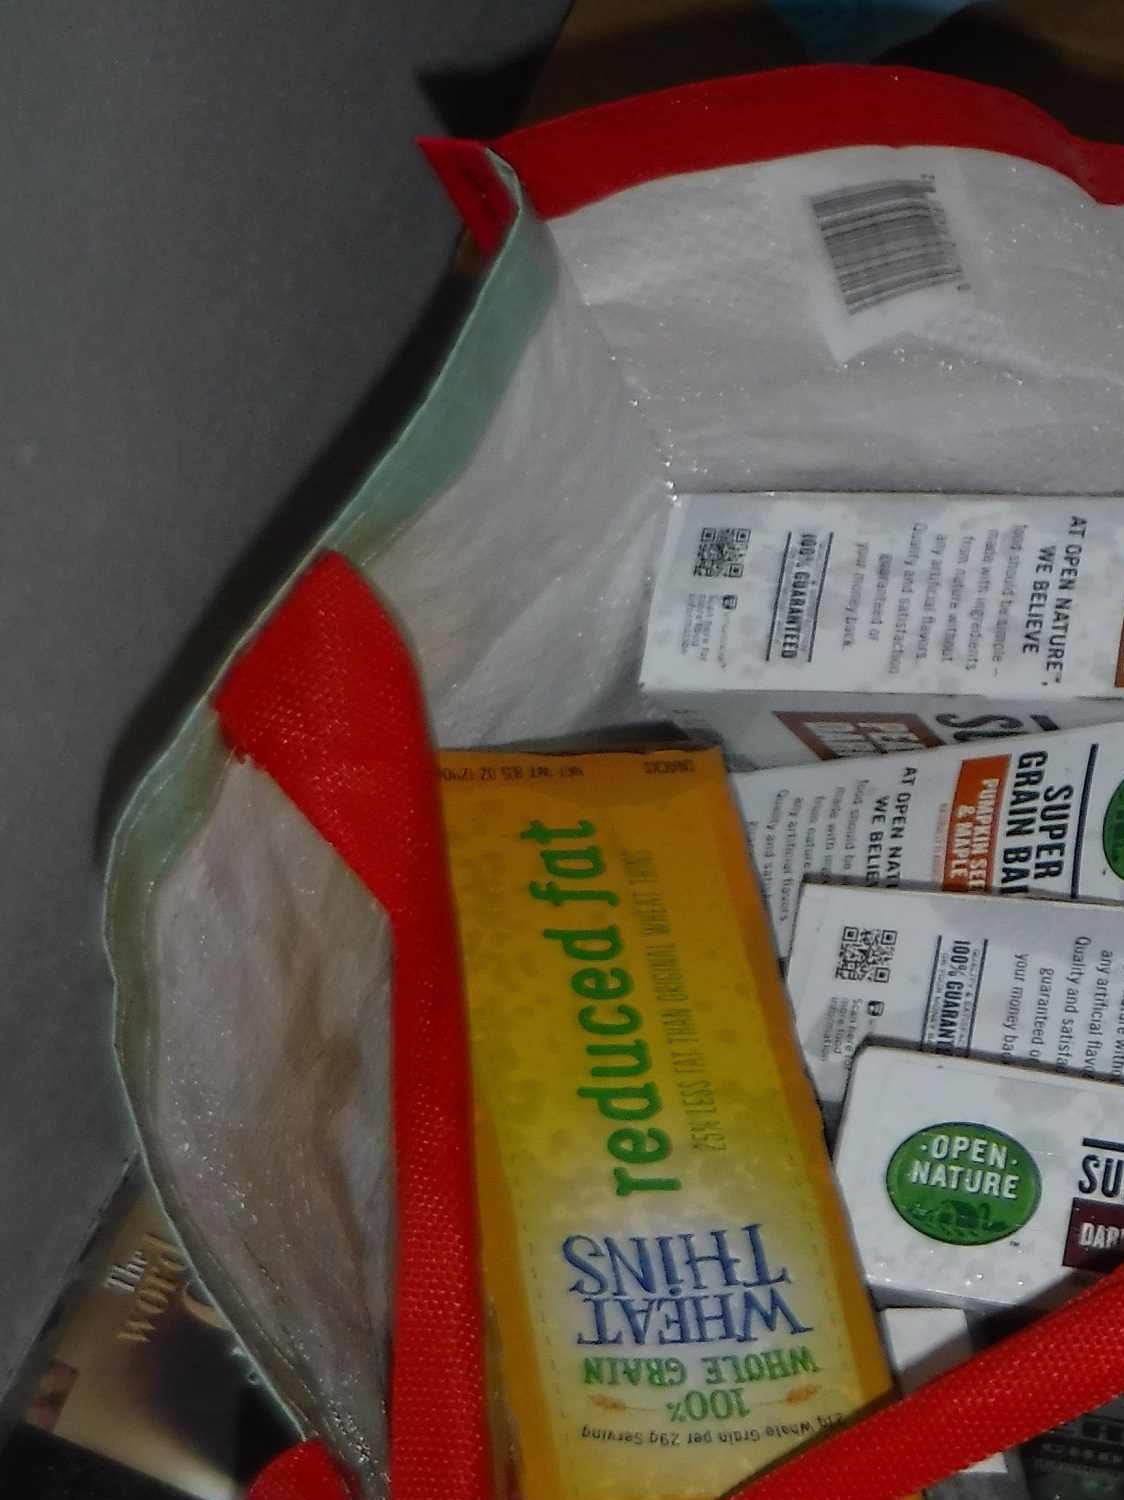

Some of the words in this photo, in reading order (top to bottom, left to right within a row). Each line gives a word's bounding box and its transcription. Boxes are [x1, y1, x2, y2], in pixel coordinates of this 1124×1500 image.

[903, 522, 928, 567] Quality
[929, 534, 949, 556] any
[982, 529, 999, 562] made
[1069, 516, 1088, 540] AT
[852, 543, 871, 569] your
[957, 536, 976, 564] from
[1035, 546, 1057, 574] WE
[1058, 544, 1082, 591] OPEN
[842, 572, 865, 614] money
[899, 570, 920, 594] and
[923, 559, 945, 613] artificial
[949, 568, 968, 609] nature
[978, 566, 997, 593] with
[1000, 555, 1022, 596] should
[780, 571, 811, 659] GUARANTEED
[998, 600, 1016, 616] be
[1022, 580, 1051, 654] BELIEVE
[888, 598, 917, 675] satisfaction
[941, 614, 965, 663] without
[965, 597, 991, 671] ingredients
[900, 766, 919, 786] AT
[1005, 751, 1048, 838] GRAIN
[766, 789, 790, 831] Quality
[788, 797, 804, 817] any
[872, 796, 890, 825] WE
[890, 792, 911, 839] OPEN
[958, 804, 976, 818] &
[971, 778, 1000, 855] PUMPKIN
[765, 834, 779, 858] and
[782, 821, 798, 874] artificial
[802, 827, 818, 869] nature
[825, 822, 839, 851] with
[950, 822, 972, 879] MAPLE
[1033, 784, 1074, 880] SUPER
[520, 820, 620, 907] fat
[843, 855, 855, 870] be
[630, 891, 671, 936] WHEAT
[645, 942, 688, 1003] ORIGINAL
[947, 940, 971, 977] 100%
[1014, 953, 1030, 981] your
[1065, 936, 1091, 984] Quality
[1091, 950, 1114, 974] any
[1003, 986, 1024, 1030] money
[1030, 967, 1056, 1046] guaranteed
[1063, 988, 1083, 1014] and
[1088, 978, 1109, 1036] artificial
[663, 1008, 700, 1043] THAN
[543, 925, 682, 1197] reduced
[673, 1047, 709, 1075] FAT
[681, 1080, 717, 1115] LESS
[931, 1134, 1007, 1168] OPEN
[911, 1160, 1020, 1201] NATURE
[577, 1288, 814, 1346] WHEAT
[581, 1356, 688, 1387] GRAIN
[701, 1345, 822, 1384] WHOLE
[666, 1385, 751, 1423] 100%
[581, 1424, 643, 1446] Serving
[649, 1429, 680, 1446] 29g
[687, 1428, 712, 1444] per
[718, 1428, 760, 1445] Grain
[765, 1420, 816, 1438] Whole
